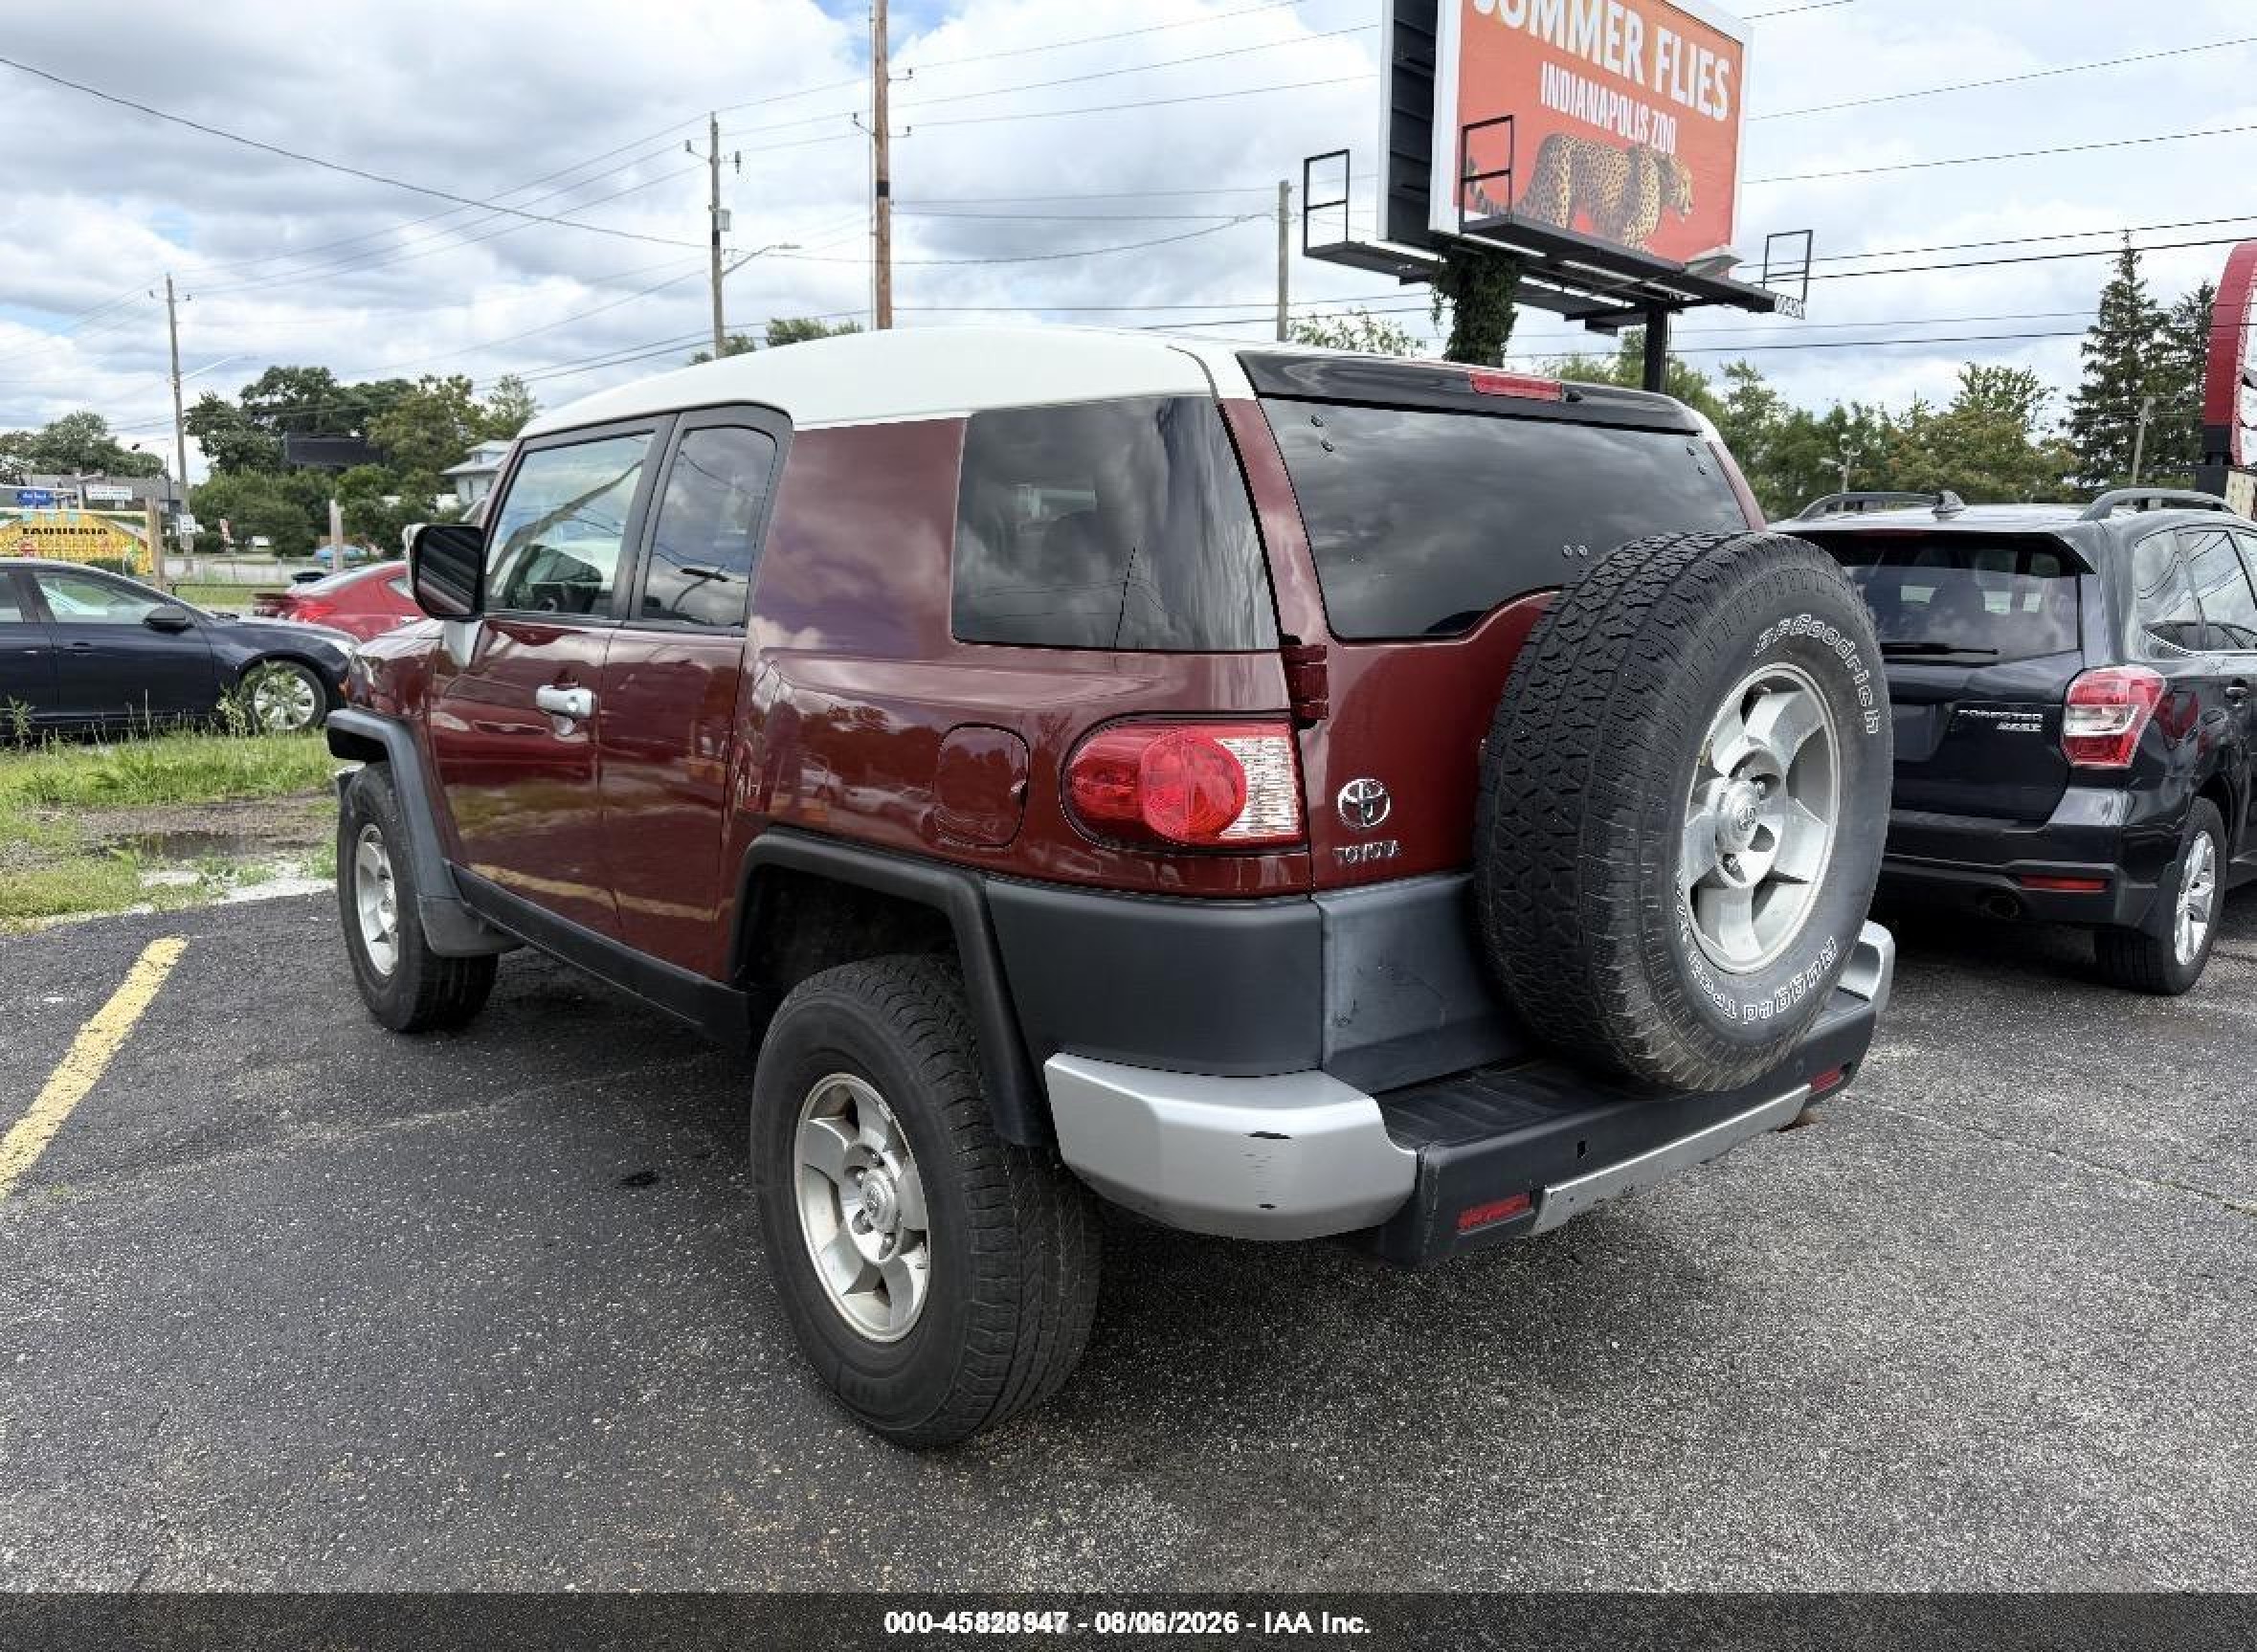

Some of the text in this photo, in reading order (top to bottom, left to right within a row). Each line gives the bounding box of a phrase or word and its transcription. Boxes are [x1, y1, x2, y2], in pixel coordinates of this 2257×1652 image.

[1472, 0, 1731, 122] MMER FLIES
[1540, 60, 1676, 155] INDIANAPOLIS ZOO
[1331, 839, 1400, 865] TOYOTA
